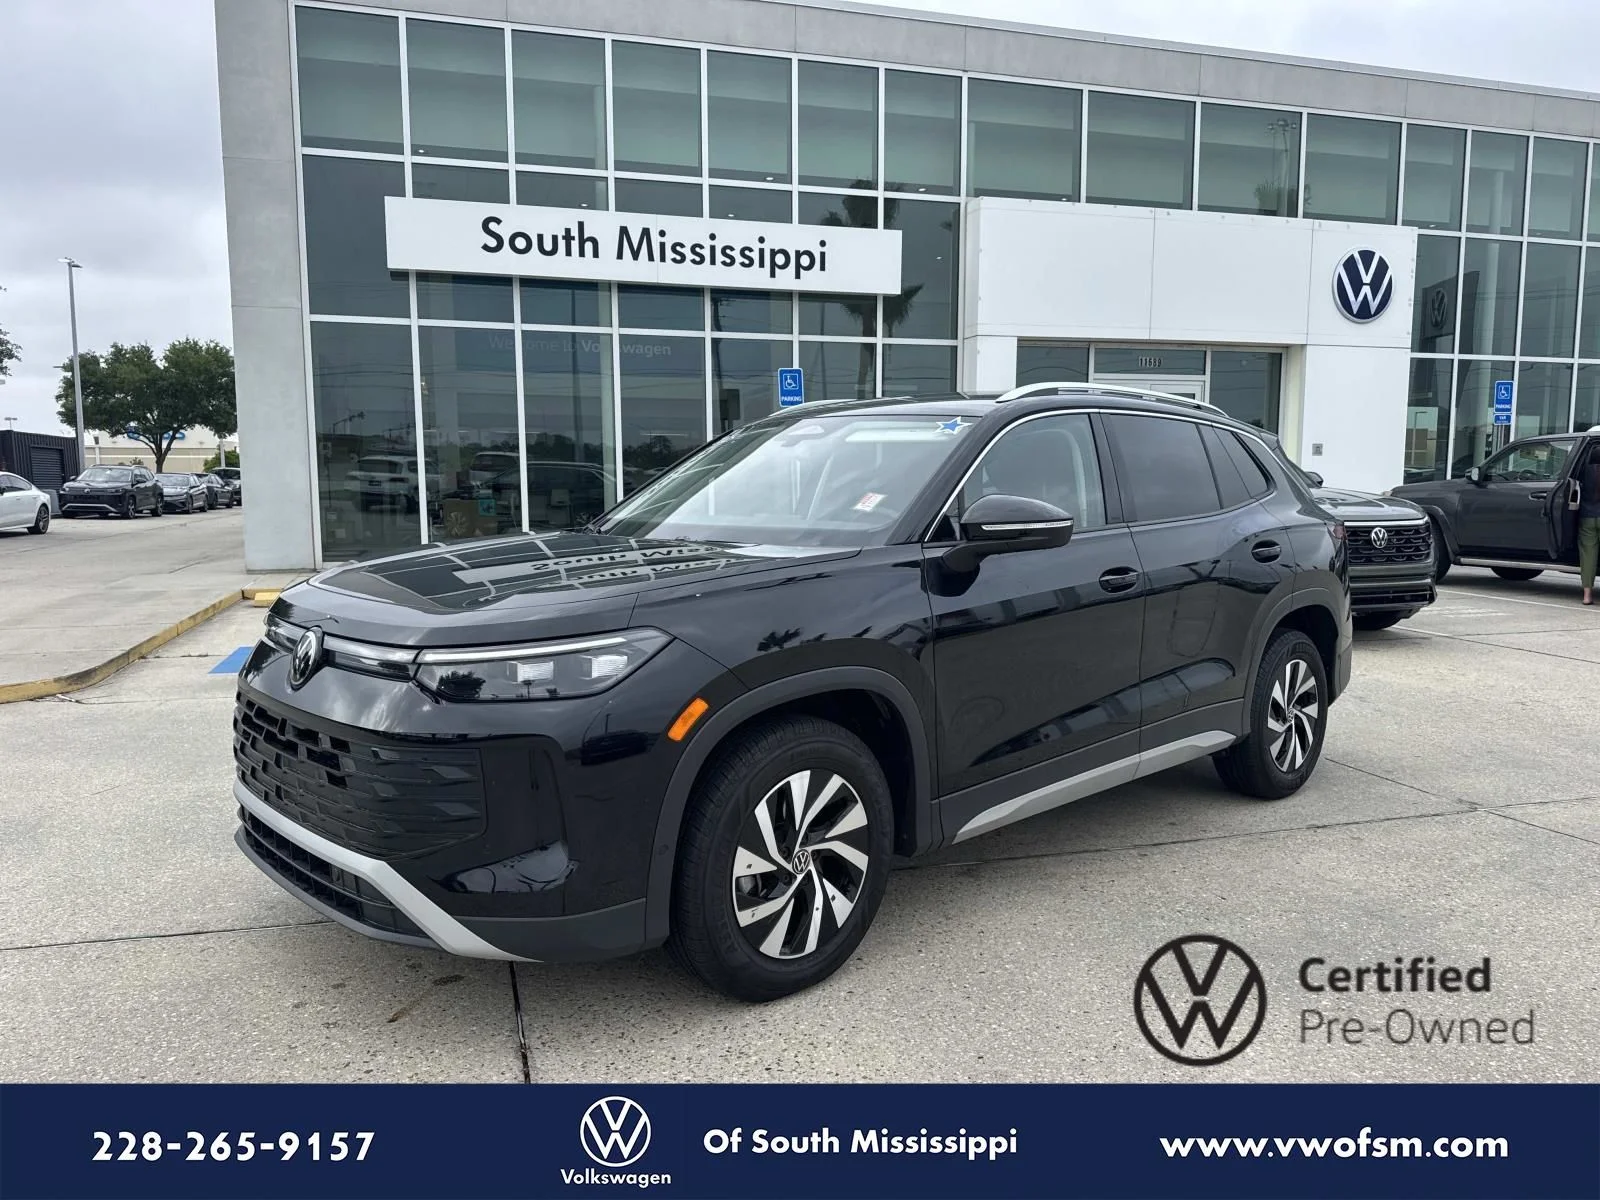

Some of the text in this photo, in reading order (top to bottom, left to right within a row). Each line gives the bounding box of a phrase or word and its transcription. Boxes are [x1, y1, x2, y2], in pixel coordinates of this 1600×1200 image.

[481, 216, 827, 280] South Mississippi
[1332, 247, 1394, 324] VW
[489, 336, 559, 352] Weome
[580, 339, 671, 357] Vowagen
